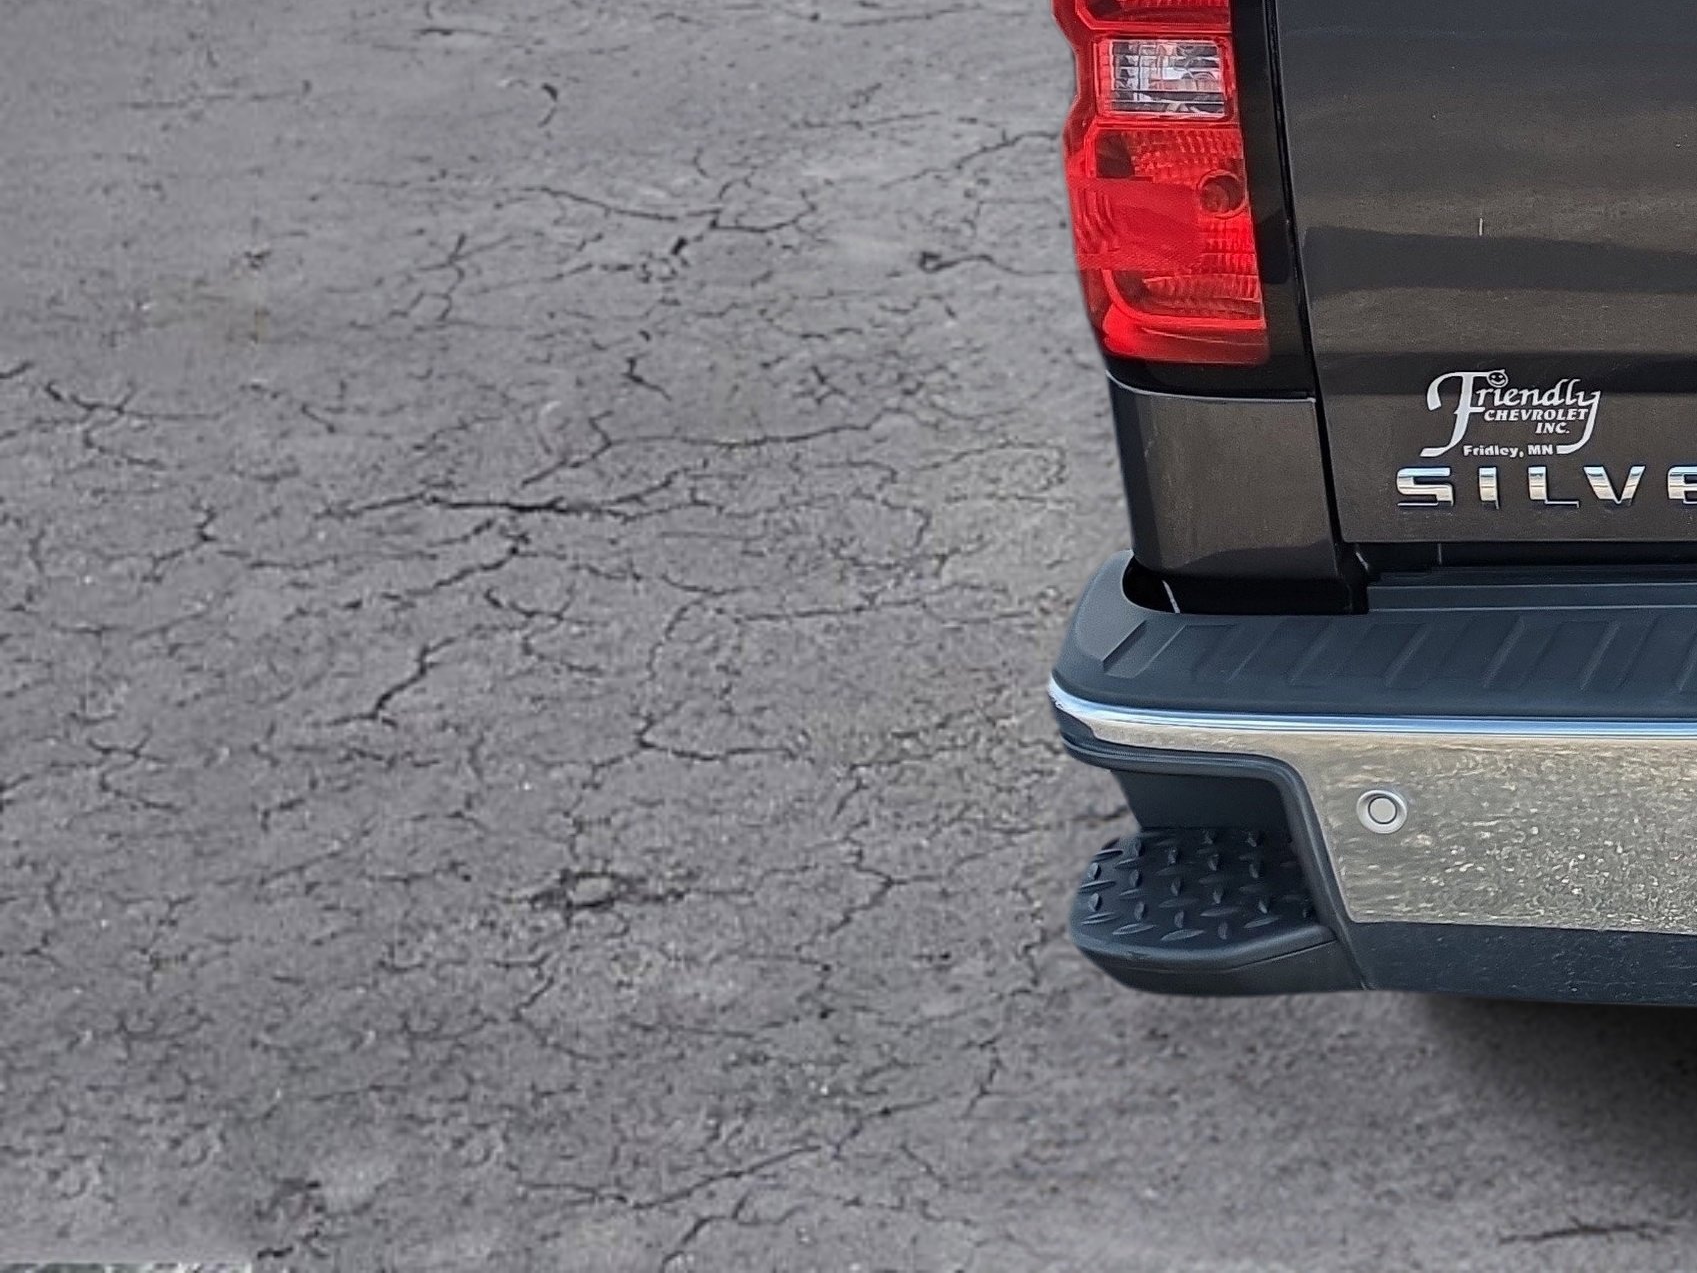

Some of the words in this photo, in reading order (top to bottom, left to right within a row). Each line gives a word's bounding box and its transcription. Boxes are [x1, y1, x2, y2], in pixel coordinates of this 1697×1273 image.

[1420, 369, 1601, 457] Friendly
[1483, 408, 1589, 422] CHEVROLET
[1535, 422, 1570, 434] INC.
[1463, 445, 1525, 458] Fridley,
[1527, 444, 1554, 455] MN
